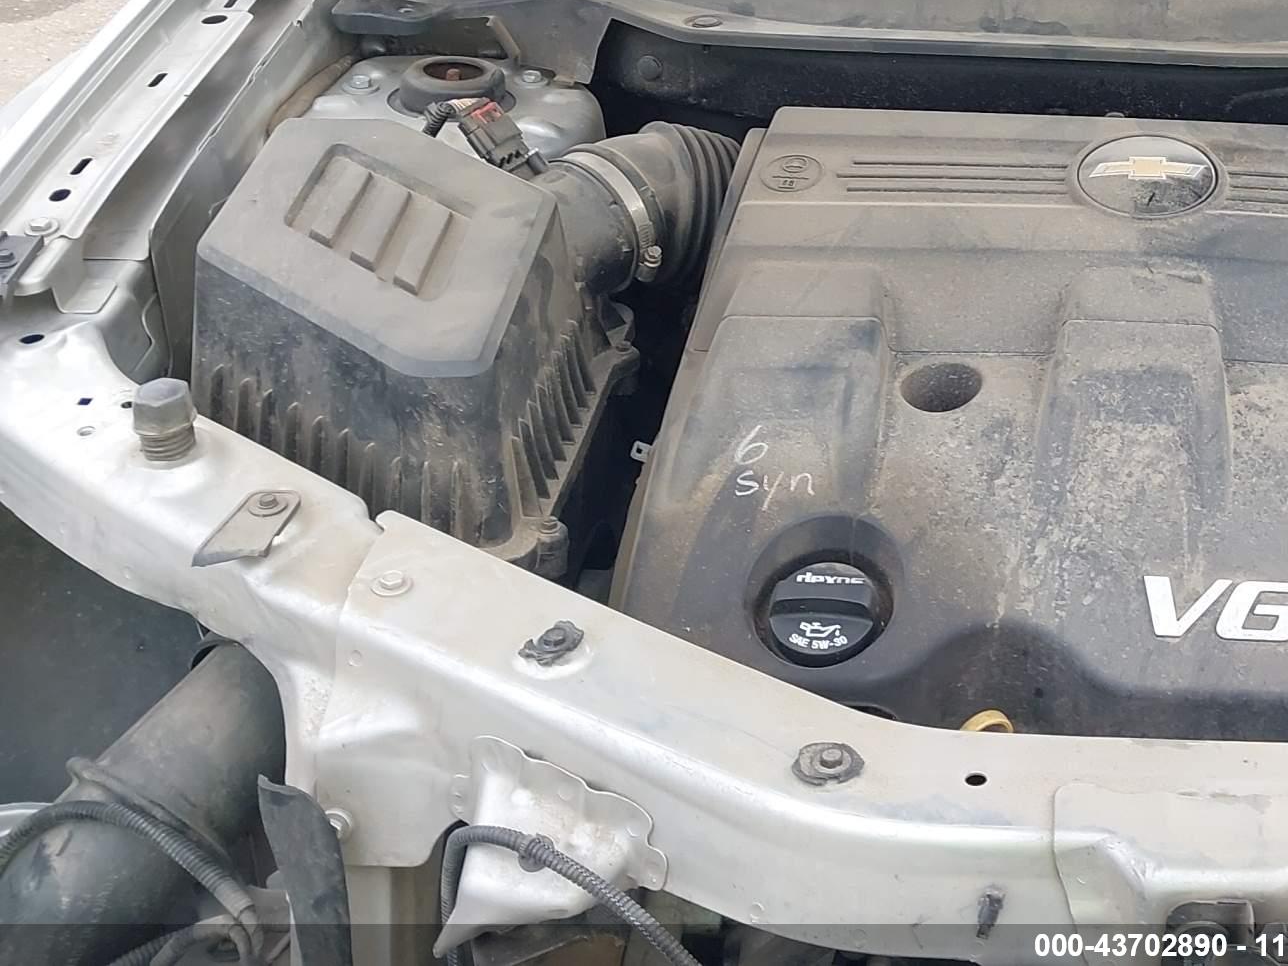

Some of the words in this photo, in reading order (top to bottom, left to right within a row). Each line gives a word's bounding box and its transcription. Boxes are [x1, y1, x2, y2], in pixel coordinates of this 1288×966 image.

[735, 425, 769, 463] 6
[789, 633, 810, 648] SAE
[811, 636, 848, 650] 5W-30
